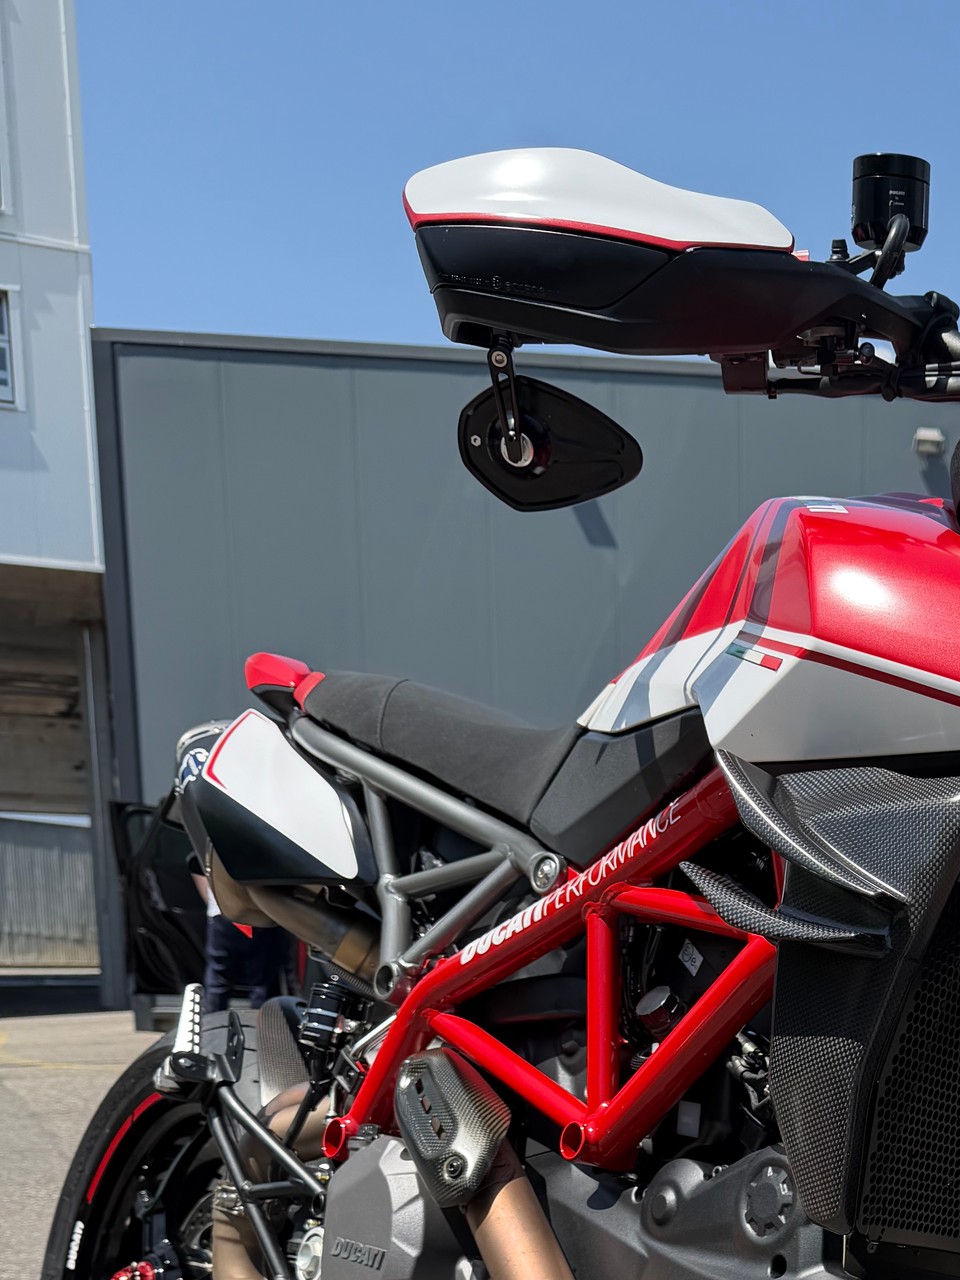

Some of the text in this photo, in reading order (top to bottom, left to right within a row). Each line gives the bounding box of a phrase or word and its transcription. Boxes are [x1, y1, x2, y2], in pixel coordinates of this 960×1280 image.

[460, 795, 683, 966] DUCATI PERFORMANCE
[331, 1236, 387, 1270] DUCATI
